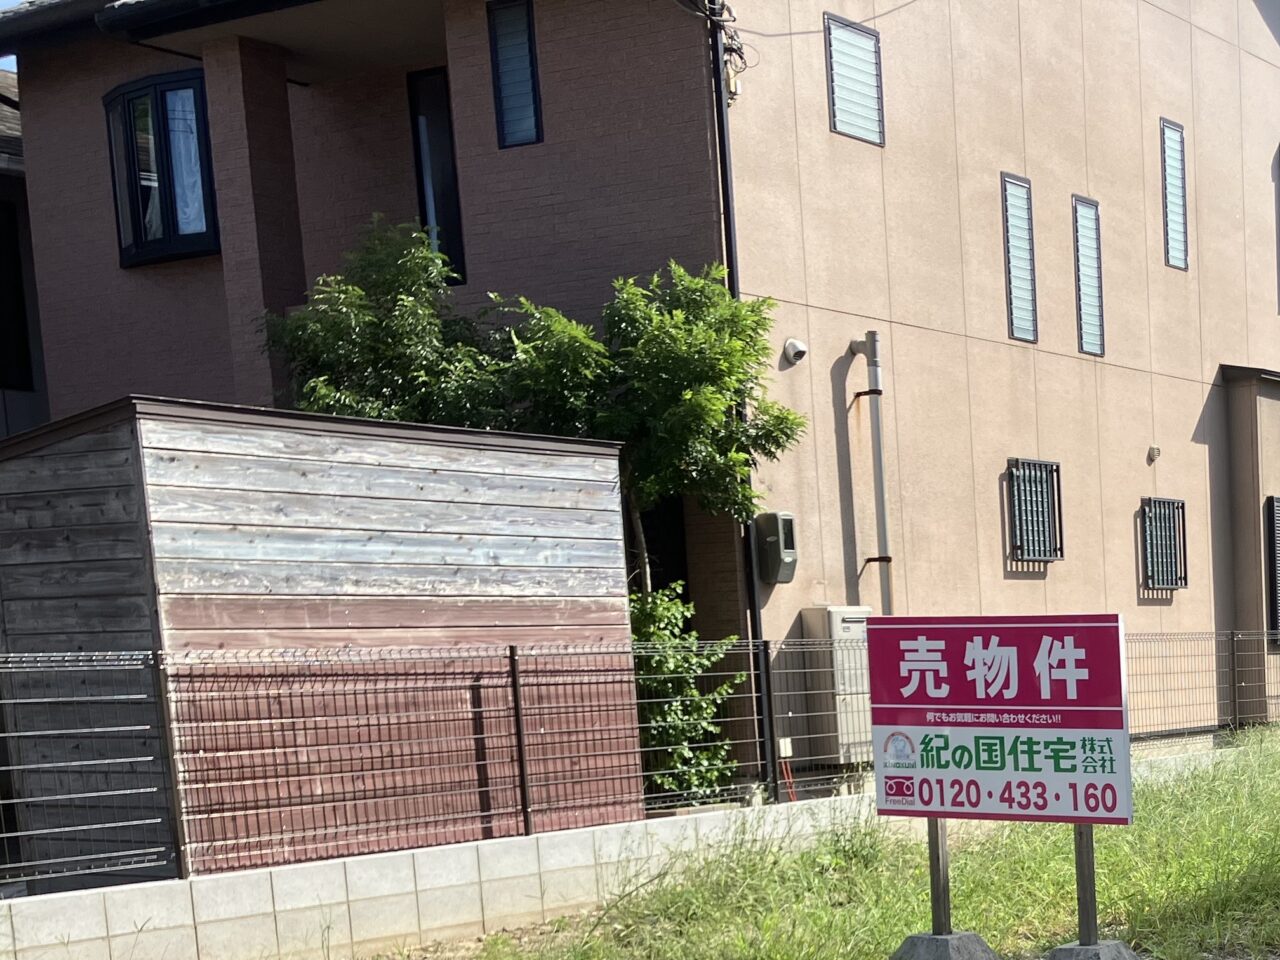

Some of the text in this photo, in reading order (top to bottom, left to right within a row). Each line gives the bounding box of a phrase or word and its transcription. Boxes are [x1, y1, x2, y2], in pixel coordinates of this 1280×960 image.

[899, 635, 1089, 700] 売物件
[919, 733, 1078, 774] 紀の国住宅
[1079, 736, 1114, 755] 株式
[1081, 756, 1118, 775] 会社
